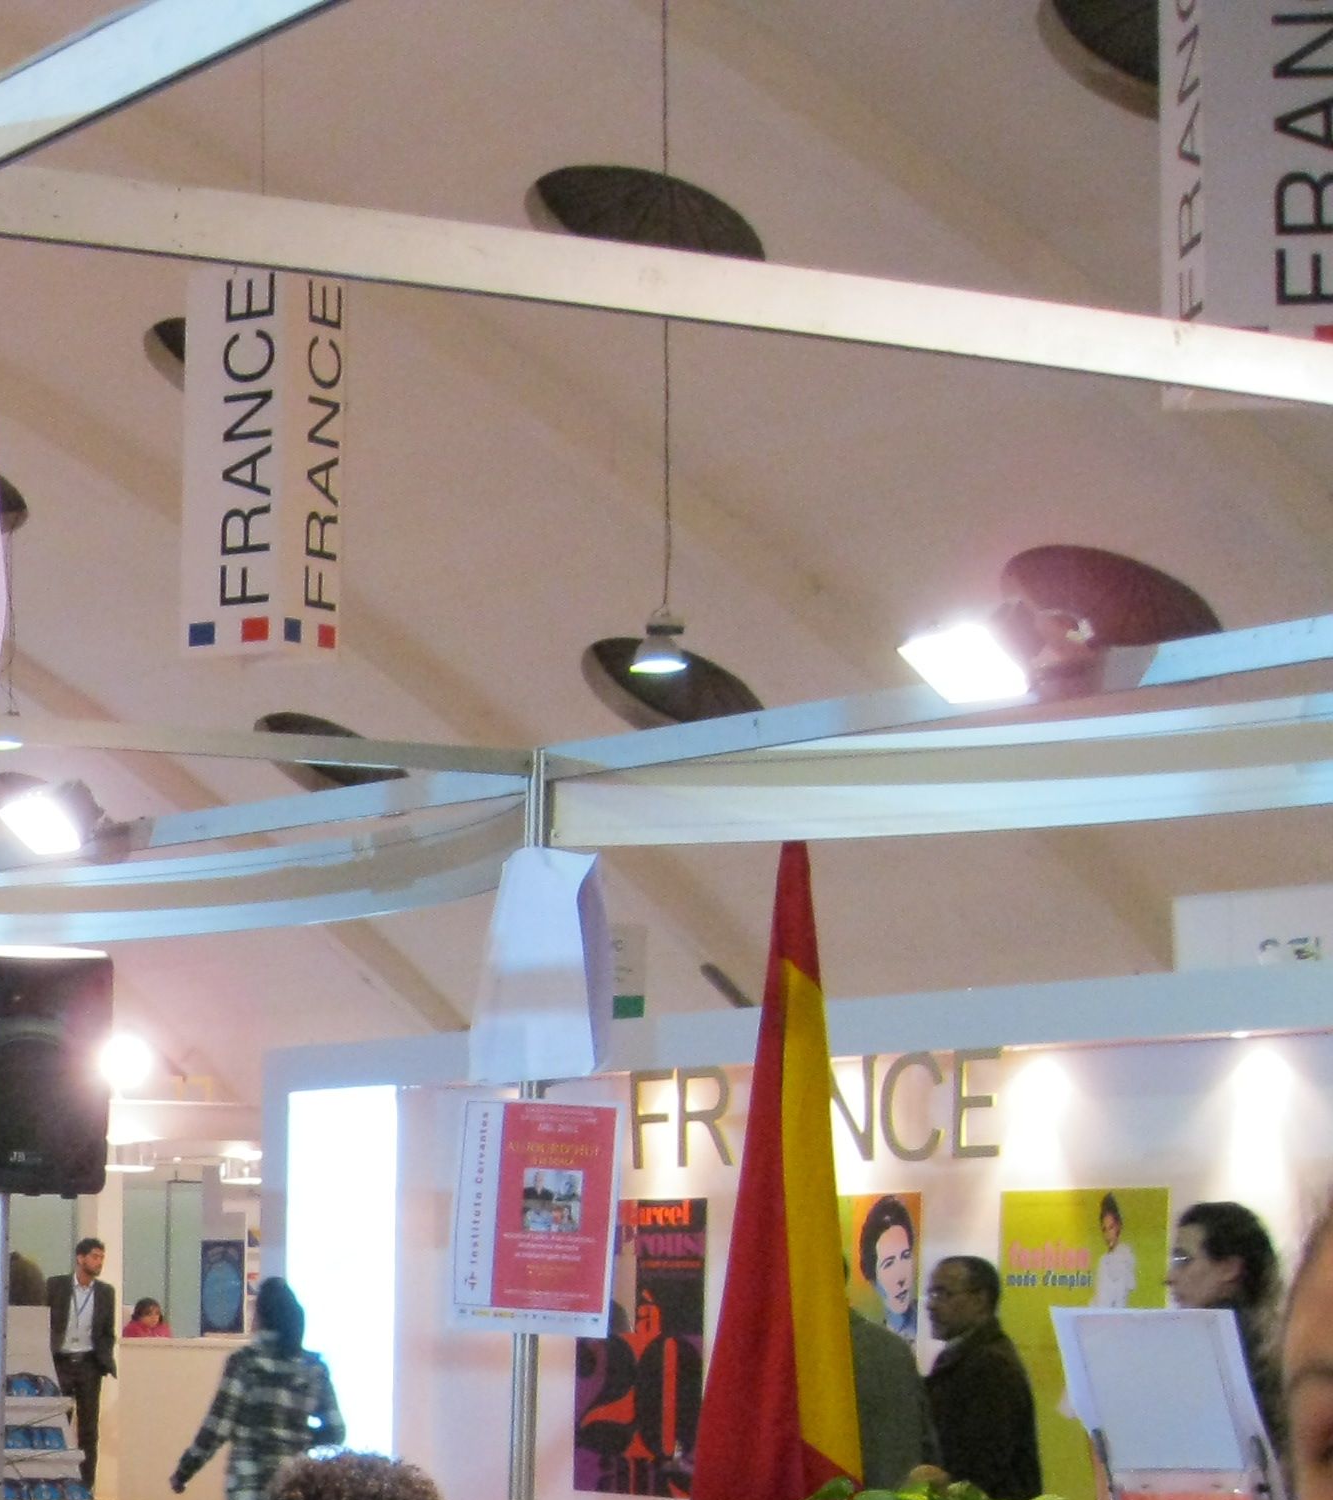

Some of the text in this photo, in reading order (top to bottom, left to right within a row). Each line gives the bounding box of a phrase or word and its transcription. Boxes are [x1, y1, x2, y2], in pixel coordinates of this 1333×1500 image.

[1175, 0, 1203, 321] FRAN
[1271, 12, 1333, 306] FRAN
[219, 271, 276, 607] FRANCE
[304, 279, 343, 612] FRANCE
[632, 1046, 1002, 1170] FRNCE
